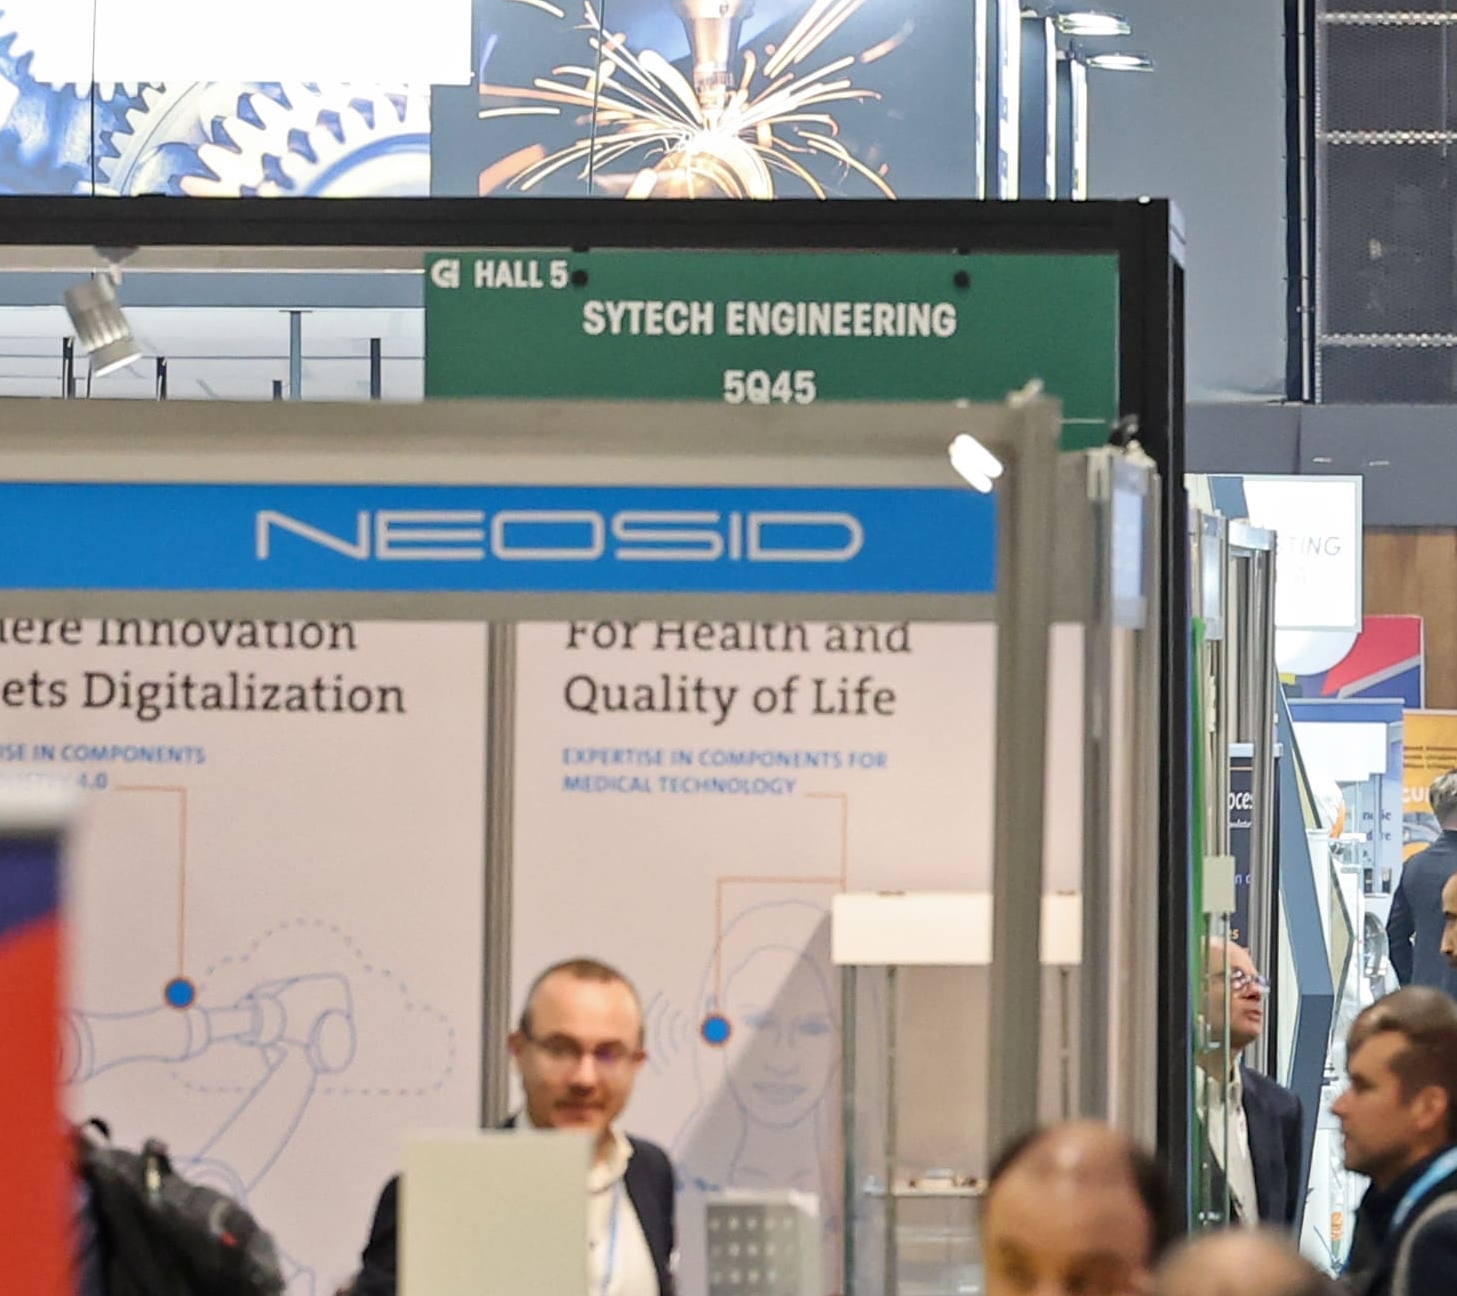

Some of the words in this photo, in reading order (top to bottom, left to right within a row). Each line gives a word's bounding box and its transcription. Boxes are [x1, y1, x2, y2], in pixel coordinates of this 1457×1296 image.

[475, 261, 543, 289] HALL
[550, 261, 569, 289] 5
[583, 303, 713, 336] SYTECH
[727, 303, 957, 338] ENGINEERING
[723, 370, 817, 404] 5Q45
[255, 510, 864, 561] NEOSID
[566, 621, 639, 650] For
[825, 621, 912, 654] and
[83, 670, 407, 723] Digitalization
[564, 673, 739, 726] Quality
[753, 675, 799, 714] of
[812, 675, 897, 715] Life
[34, 744, 56, 762] IN
[62, 745, 206, 765] COMPONENTS
[562, 748, 663, 766] EXPERTISE
[671, 750, 692, 766] IN
[698, 750, 843, 768] COMPONENTS
[848, 752, 888, 769] FOR
[561, 776, 652, 793] MEDICAL
[660, 776, 797, 795] TECHNOLOGY
